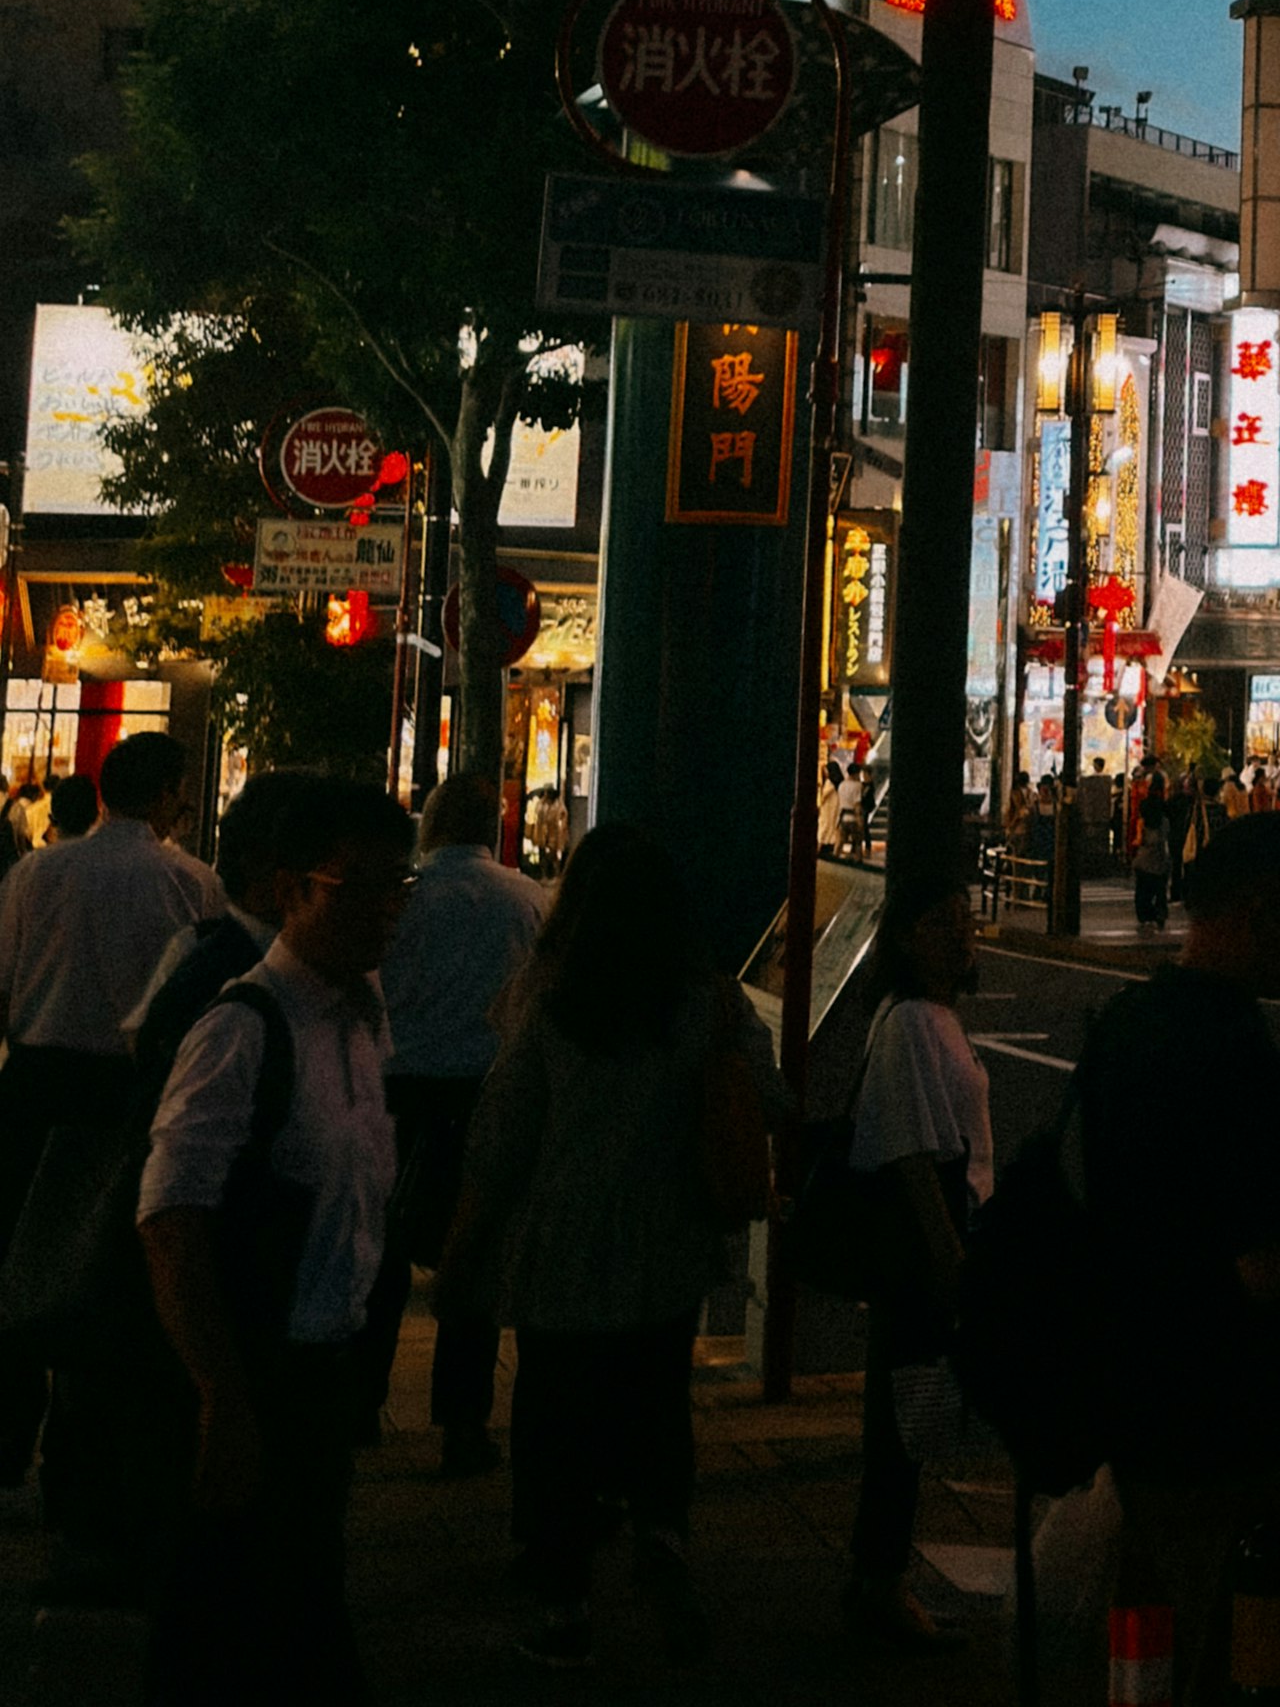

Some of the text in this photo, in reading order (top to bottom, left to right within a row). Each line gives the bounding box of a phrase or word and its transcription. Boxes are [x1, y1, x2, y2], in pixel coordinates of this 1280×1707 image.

[619, 23, 782, 101] 消火栓
[324, 423, 368, 434] HYDRAN
[708, 323, 766, 490] 陽門
[292, 438, 378, 477] 消火栓
